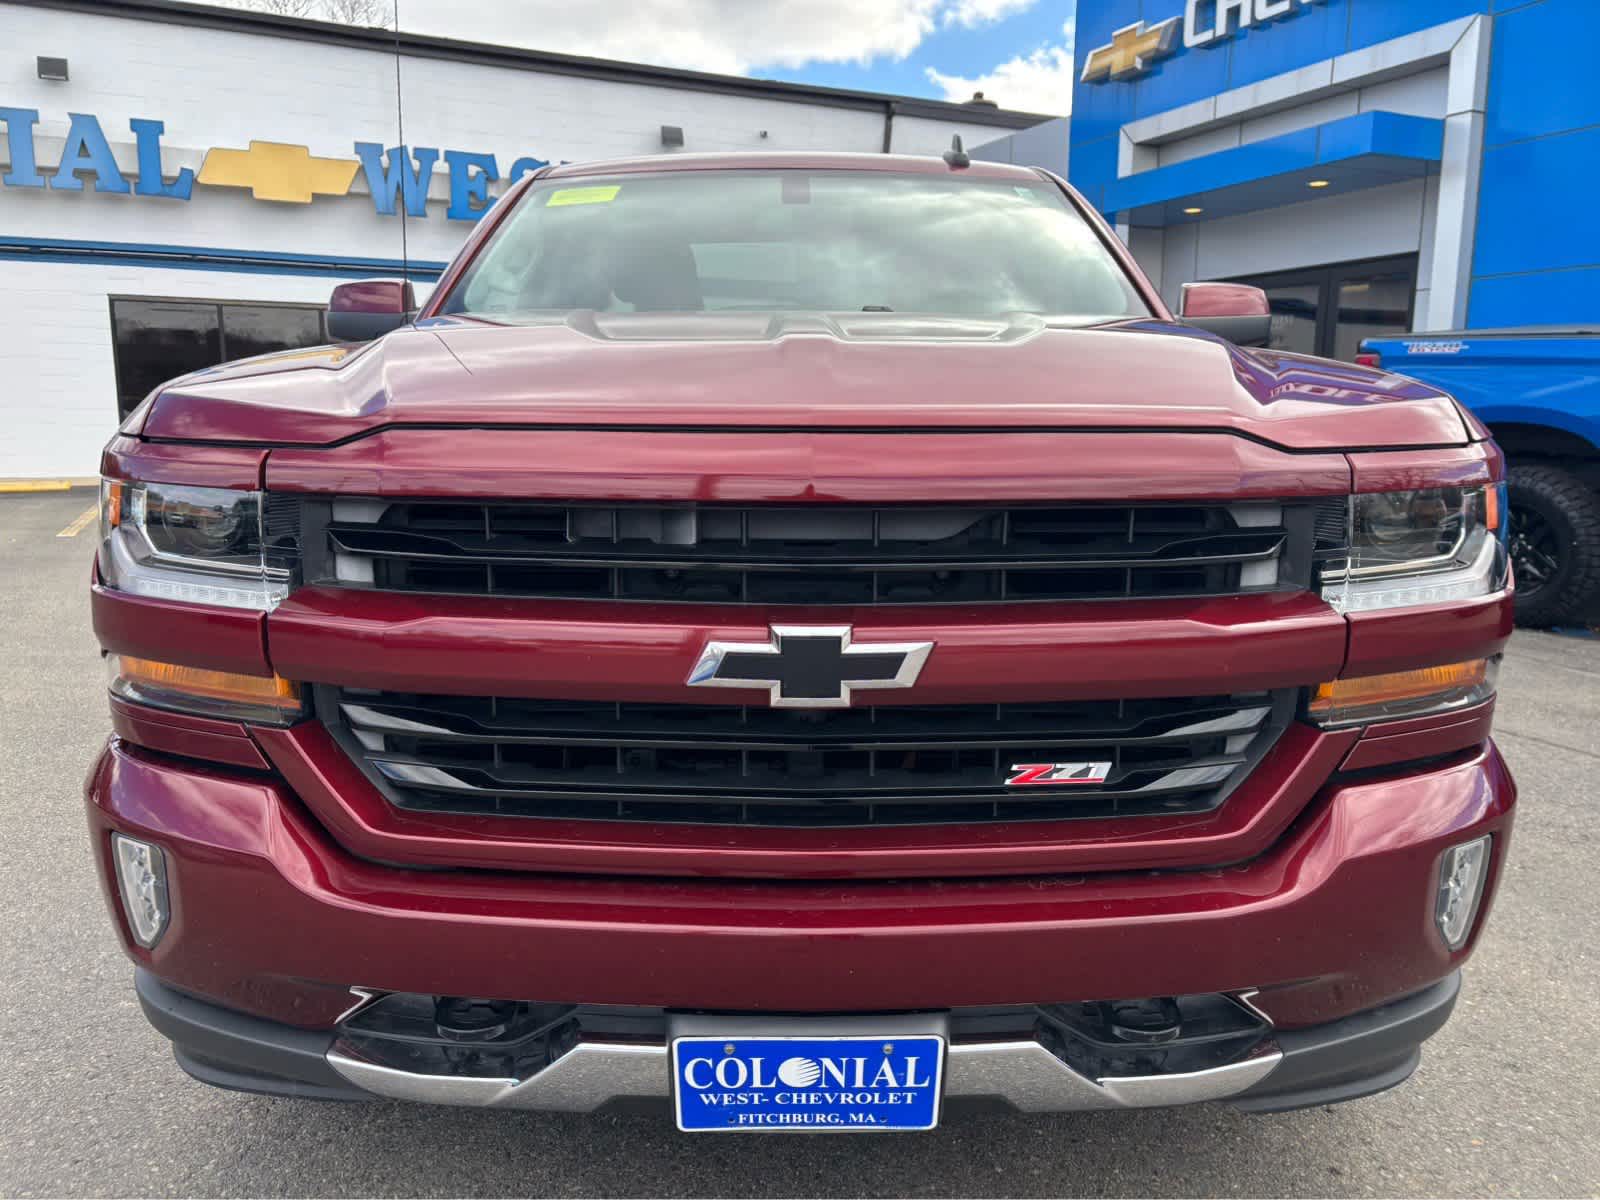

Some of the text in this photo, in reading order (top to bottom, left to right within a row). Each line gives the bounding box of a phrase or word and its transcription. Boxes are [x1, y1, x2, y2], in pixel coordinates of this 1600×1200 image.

[1004, 761, 1113, 785] Z71
[684, 1056, 930, 1089] COLONIAL
[700, 1092, 918, 1105] WEST- CHEVROLET
[738, 1113, 876, 1125] FITCHBURG, MA
